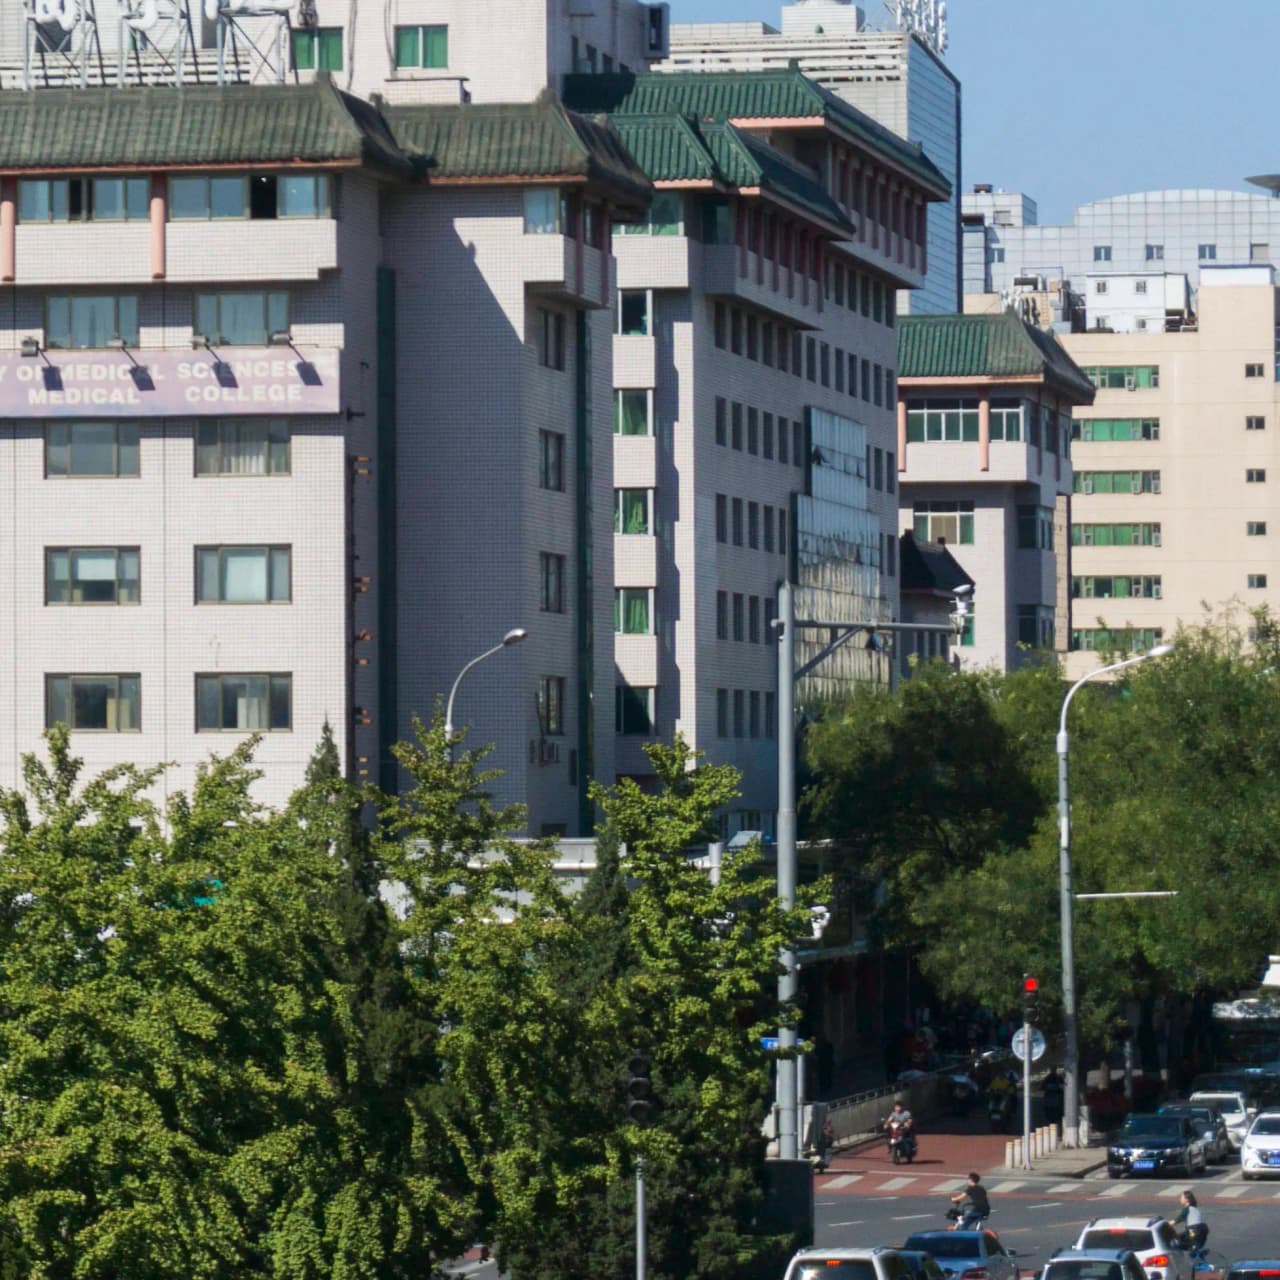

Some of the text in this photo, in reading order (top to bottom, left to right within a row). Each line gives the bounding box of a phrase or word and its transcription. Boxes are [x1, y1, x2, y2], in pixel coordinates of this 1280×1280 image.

[54, 364, 164, 381] MEDICL
[176, 361, 300, 380] SCNCES
[28, 388, 141, 405] MEDICAL
[185, 384, 302, 402] COLLEGE
